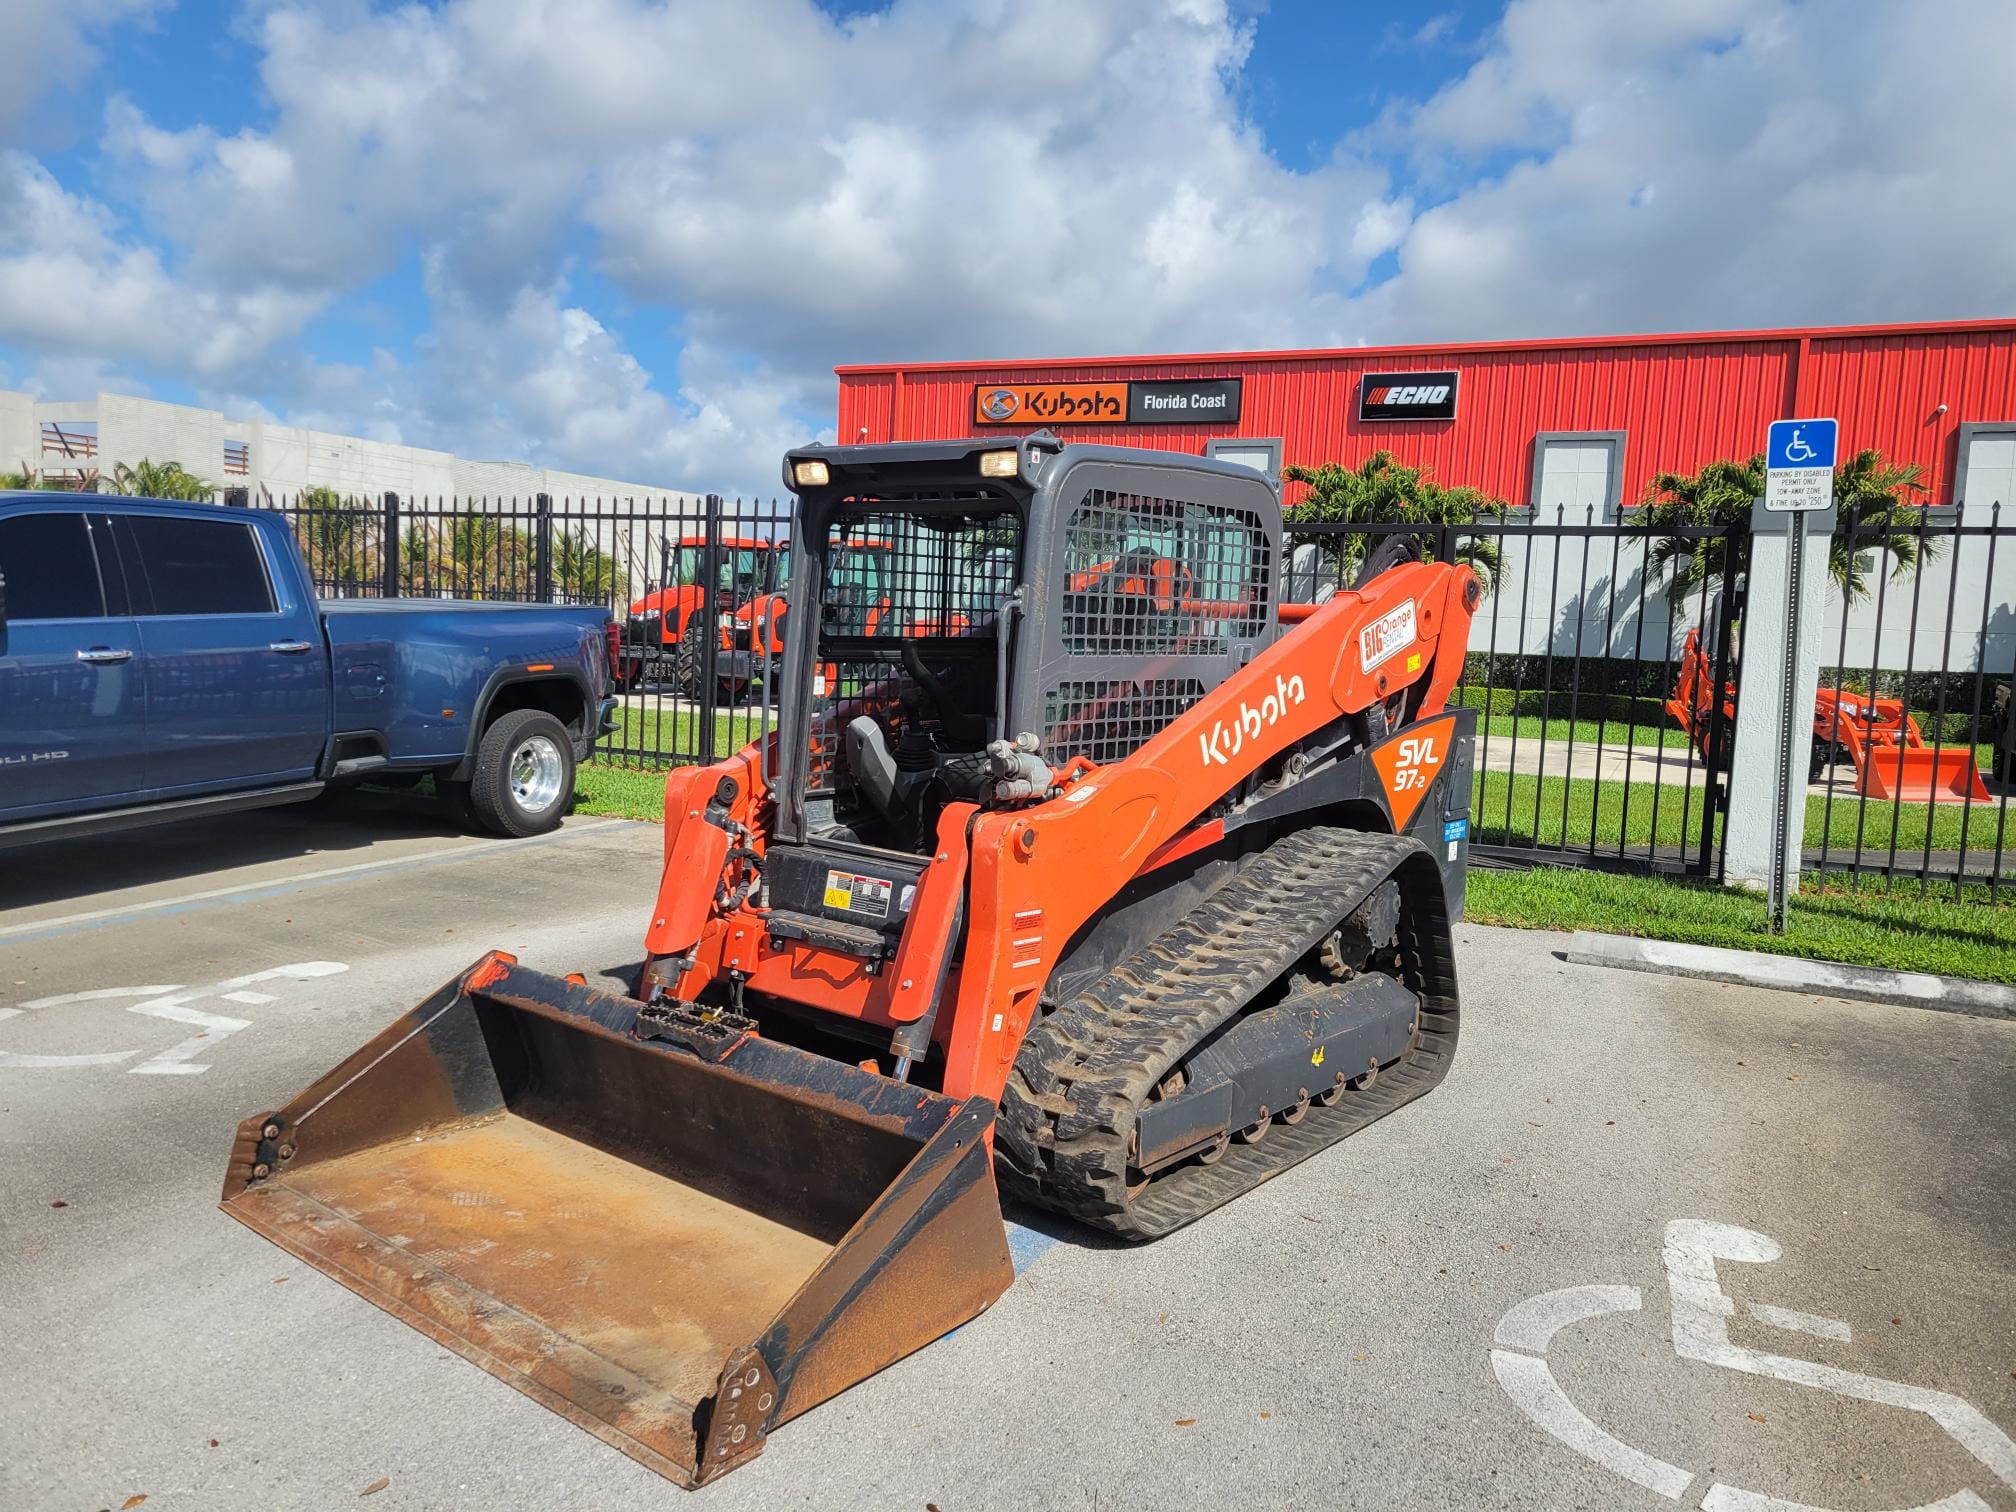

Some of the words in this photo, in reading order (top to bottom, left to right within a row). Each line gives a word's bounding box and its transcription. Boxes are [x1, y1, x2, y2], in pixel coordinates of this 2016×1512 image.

[1025, 390, 1120, 416] Kubota
[1144, 394, 1187, 409] Florida
[1191, 393, 1226, 409] Coast
[1383, 385, 1450, 405] ECHO
[1769, 471, 1793, 479] PARKING
[1803, 469, 1830, 477] DISABLED
[1364, 622, 1384, 662] BIG
[1381, 609, 1412, 635] Orange
[1382, 627, 1404, 648] RENTAL
[1199, 673, 1306, 767] Kubota
[0, 754, 27, 764] LI
[32, 751, 69, 761] HD
[1395, 737, 1439, 768] SVL
[1393, 768, 1426, 792] 97-2
